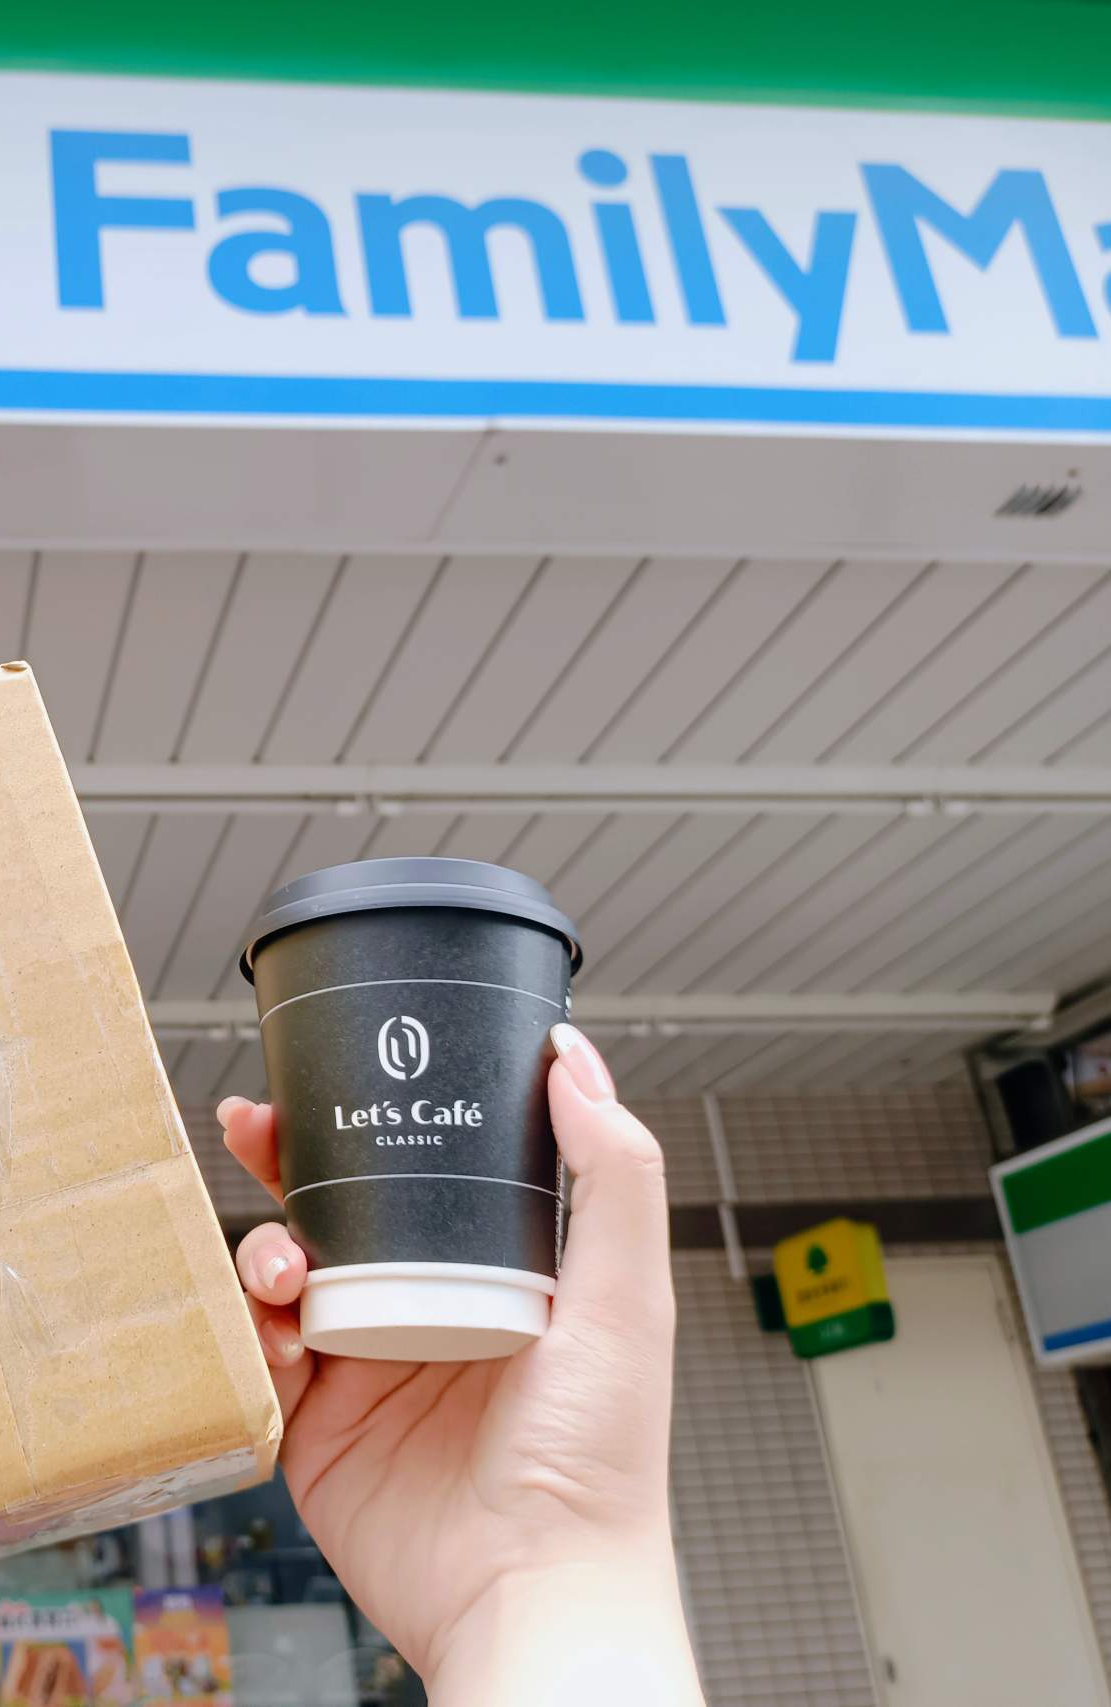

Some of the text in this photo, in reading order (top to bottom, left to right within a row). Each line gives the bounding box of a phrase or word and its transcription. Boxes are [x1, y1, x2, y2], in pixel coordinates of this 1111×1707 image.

[49, 129, 1111, 364] FamilyM
[334, 1099, 484, 1130] Let's Café
[375, 1134, 444, 1147] CLASSIC
